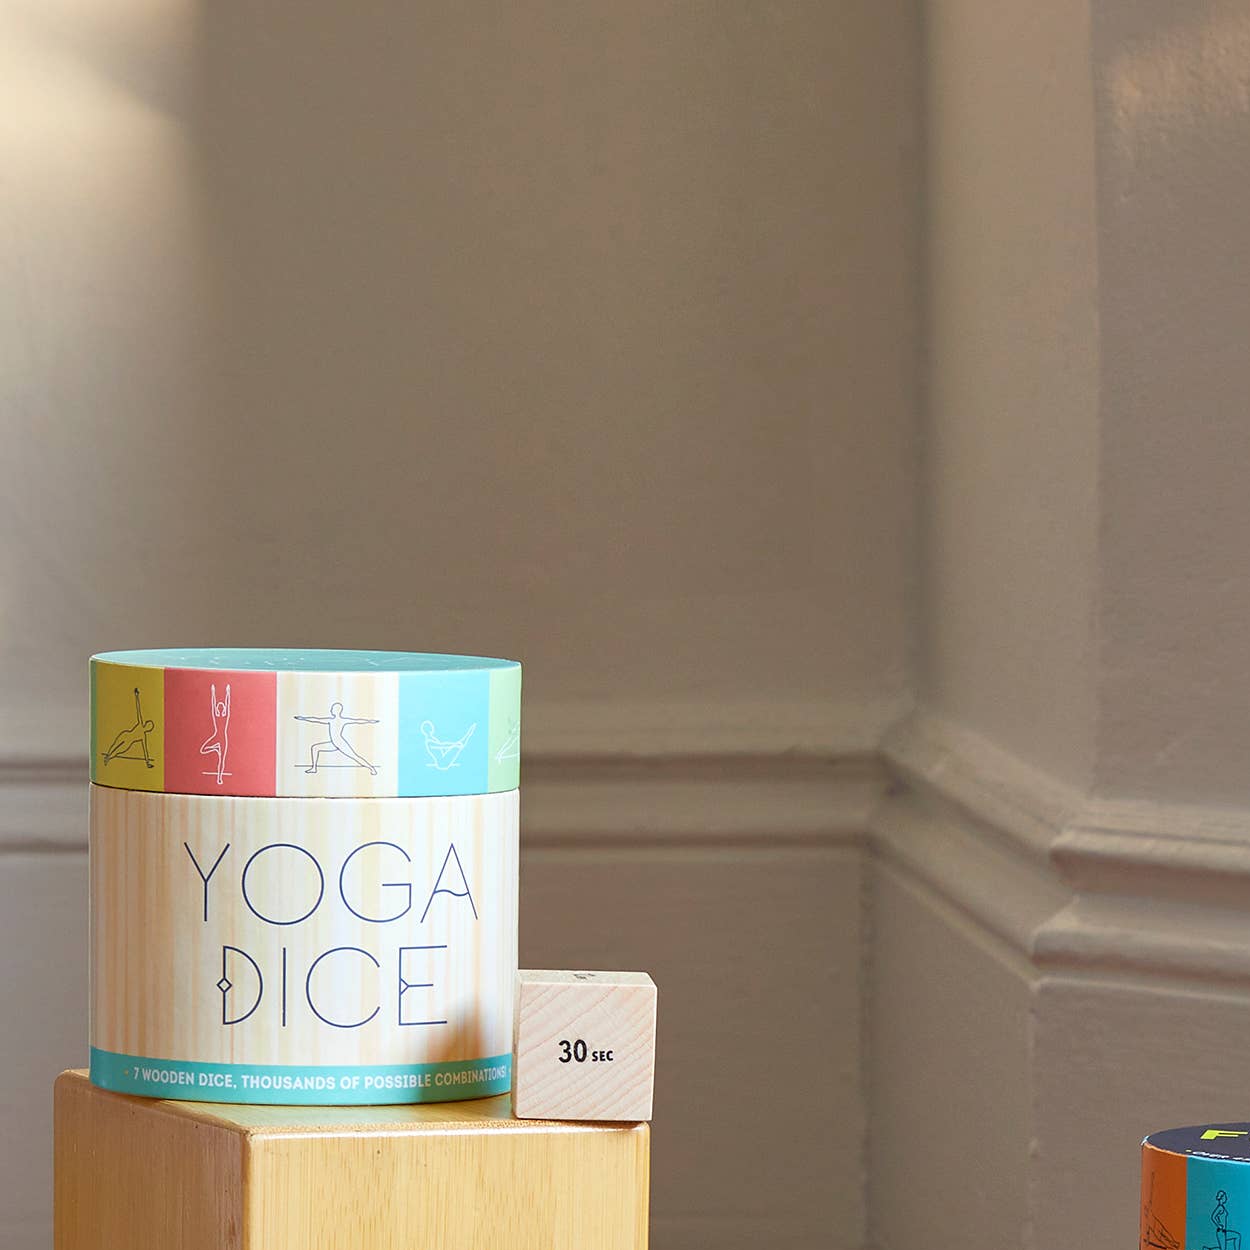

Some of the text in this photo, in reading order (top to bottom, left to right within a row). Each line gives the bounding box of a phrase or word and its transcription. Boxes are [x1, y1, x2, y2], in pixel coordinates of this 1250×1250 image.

[184, 841, 478, 924] YOGA
[216, 945, 448, 1028] DICE
[133, 1067, 139, 1080] 7
[141, 1069, 195, 1086] WOODEN
[199, 1073, 237, 1089] DICE,
[241, 1075, 336, 1090] THOUSANDS
[340, 1076, 360, 1090] OF
[365, 1074, 432, 1089] POSSIBLE
[557, 1039, 614, 1064] 30 SEC
